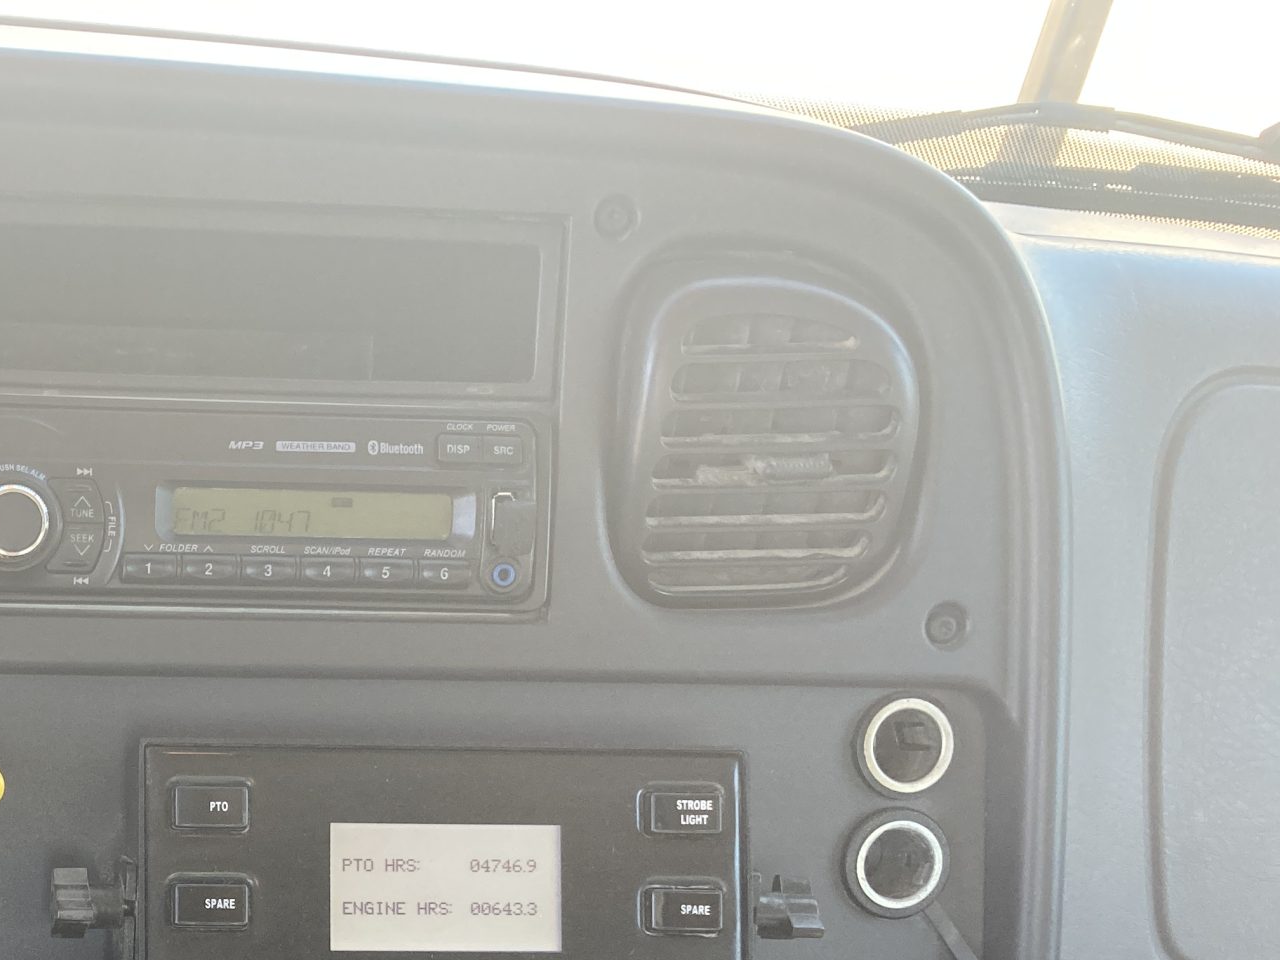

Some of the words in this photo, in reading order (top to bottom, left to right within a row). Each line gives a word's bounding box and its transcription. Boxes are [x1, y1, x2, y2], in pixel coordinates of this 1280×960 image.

[446, 423, 473, 431] CLOCK
[487, 424, 516, 432] POWER
[229, 441, 265, 450] MP3
[281, 442, 325, 450] WEATHER
[327, 443, 351, 451] BAND
[380, 442, 424, 455] Bluetooth
[447, 445, 470, 454] DISP
[493, 446, 514, 455] SRC
[70, 509, 95, 518] TUNE
[108, 516, 116, 537] FILE
[70, 533, 95, 543] SEEK
[159, 544, 198, 552] FOLDER
[250, 545, 286, 554] SCROLL
[304, 547, 351, 555] SCAN/iPod
[368, 548, 406, 557] REPEAT
[424, 549, 466, 558] RANDOM
[144, 563, 152, 574] 1
[204, 563, 213, 575] 2
[264, 565, 273, 577] 3
[322, 566, 332, 577] 4
[381, 567, 390, 579] 5
[440, 568, 449, 580] 6
[209, 802, 229, 812] PTO
[676, 800, 713, 811] STROBE
[680, 815, 709, 825] LIGHT
[342, 858, 374, 872] PTO
[384, 859, 421, 872] HRS:
[470, 859, 537, 873] 04746.9
[205, 899, 236, 910] SPARE
[342, 902, 406, 915] ENGINE
[417, 902, 453, 915] HRS:
[470, 902, 537, 916] 00643.3
[680, 905, 711, 915] SPARE
